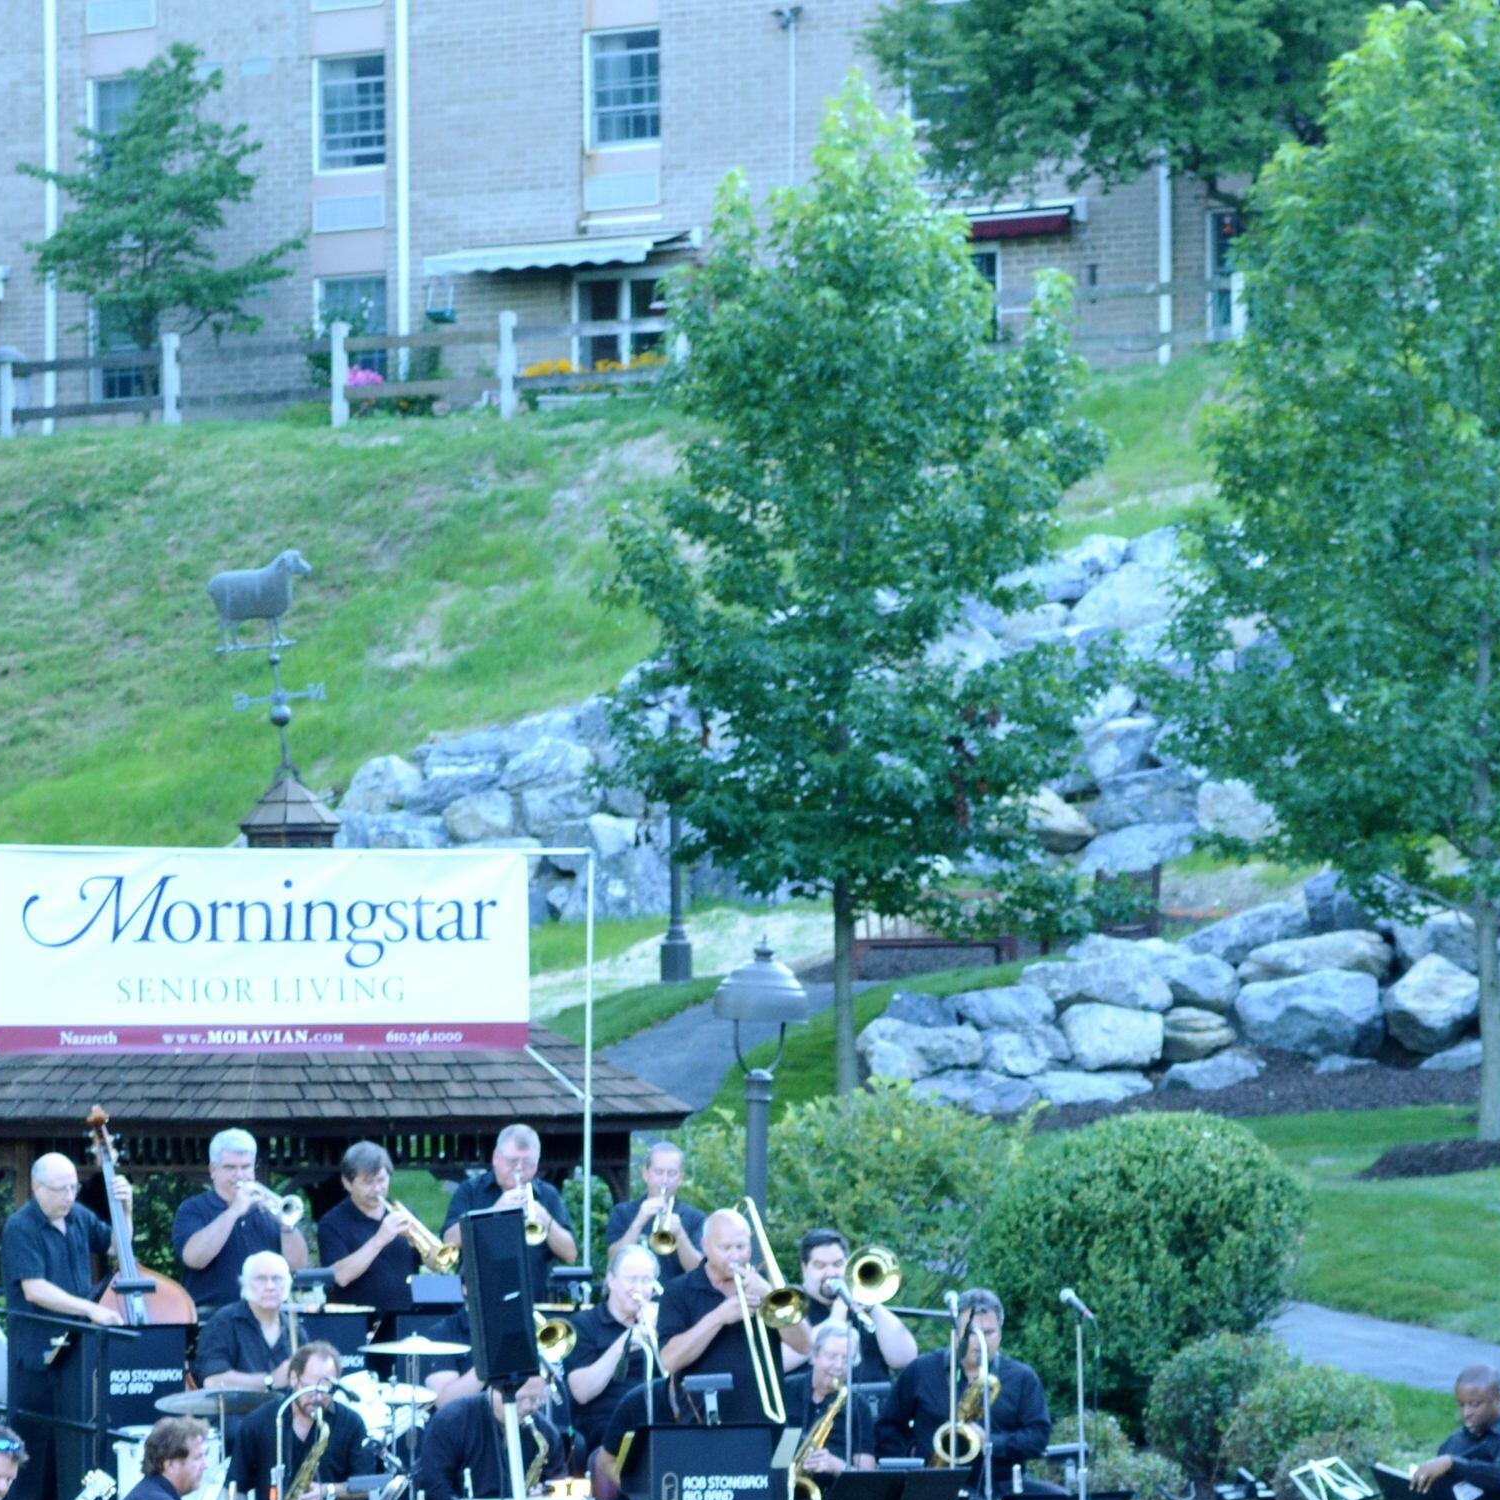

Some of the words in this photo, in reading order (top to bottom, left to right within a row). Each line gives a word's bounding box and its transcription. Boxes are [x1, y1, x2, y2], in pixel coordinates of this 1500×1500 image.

[22, 873, 498, 968] Morningstar
[116, 976, 254, 1004] SENIOR
[272, 975, 406, 1003] LIVING
[59, 1030, 118, 1046] Nazareth
[682, 1476, 706, 1490] ROB
[707, 1475, 768, 1489] STONEBACK
